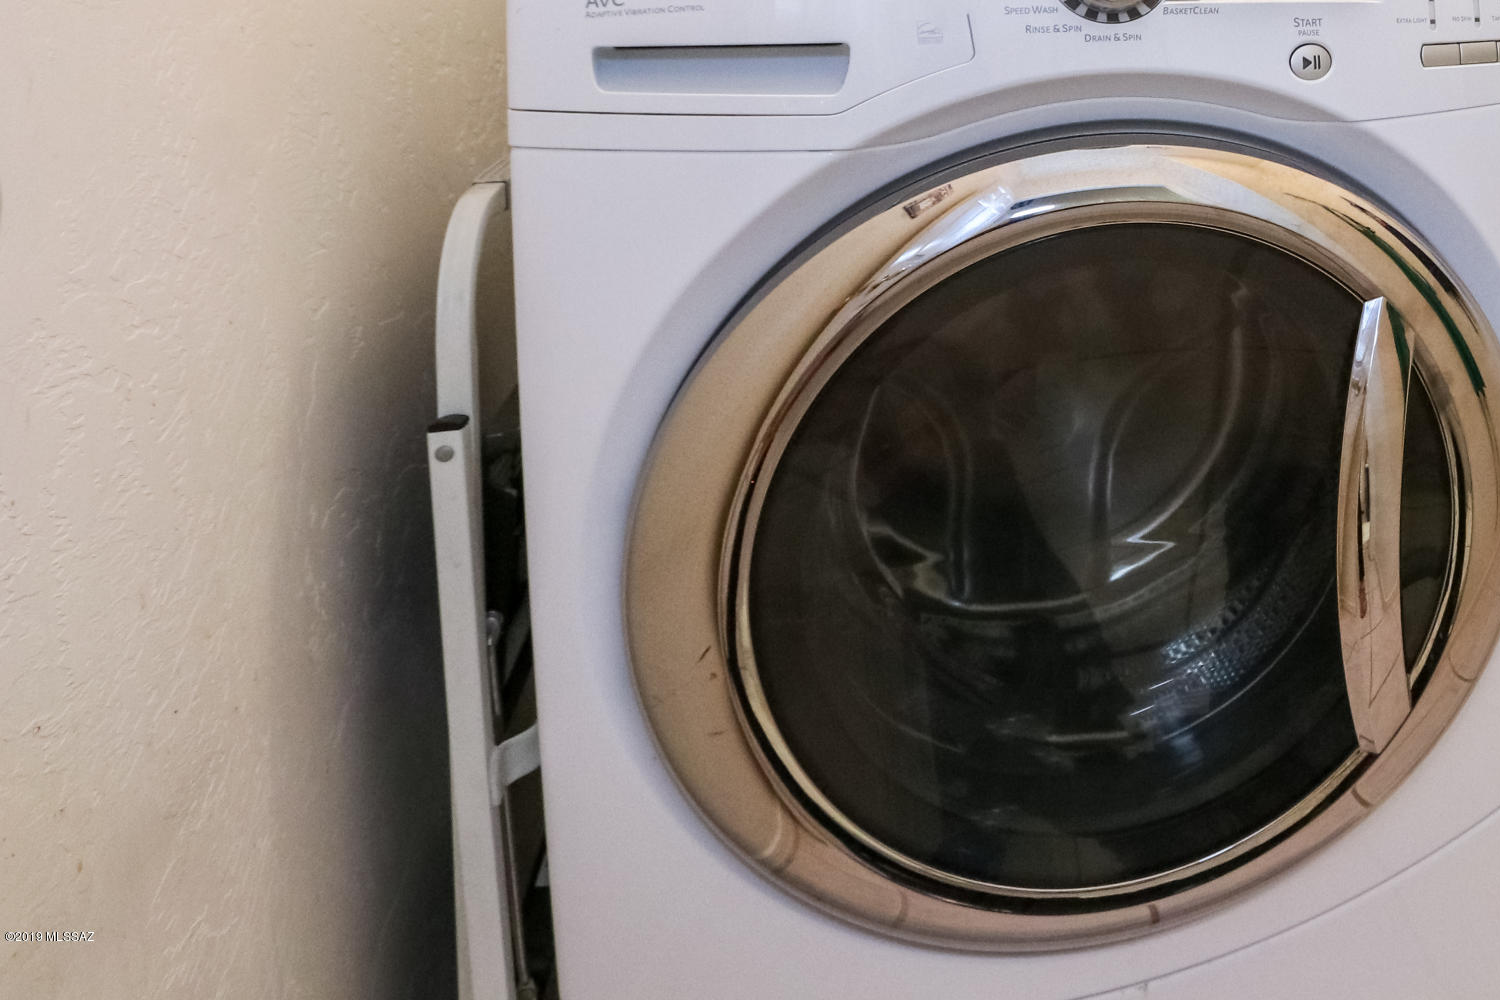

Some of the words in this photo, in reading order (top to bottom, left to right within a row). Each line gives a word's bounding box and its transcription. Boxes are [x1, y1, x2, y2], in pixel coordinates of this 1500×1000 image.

[585, 9, 623, 18] ADAPTIVE
[624, 6, 666, 16] VIBRATION
[667, 4, 704, 13] CONTROL
[1004, 6, 1031, 15] SPEED
[1031, 6, 1059, 15] WASH
[1163, 6, 1220, 16] BASKETCLEAN
[1294, 18, 1323, 27] START
[1025, 24, 1051, 34] RINSE
[1053, 24, 1061, 33] &
[1062, 24, 1083, 33] SPIN
[1084, 34, 1112, 43] DRAIN
[1113, 33, 1121, 42] &
[1122, 33, 1142, 42] SPIN
